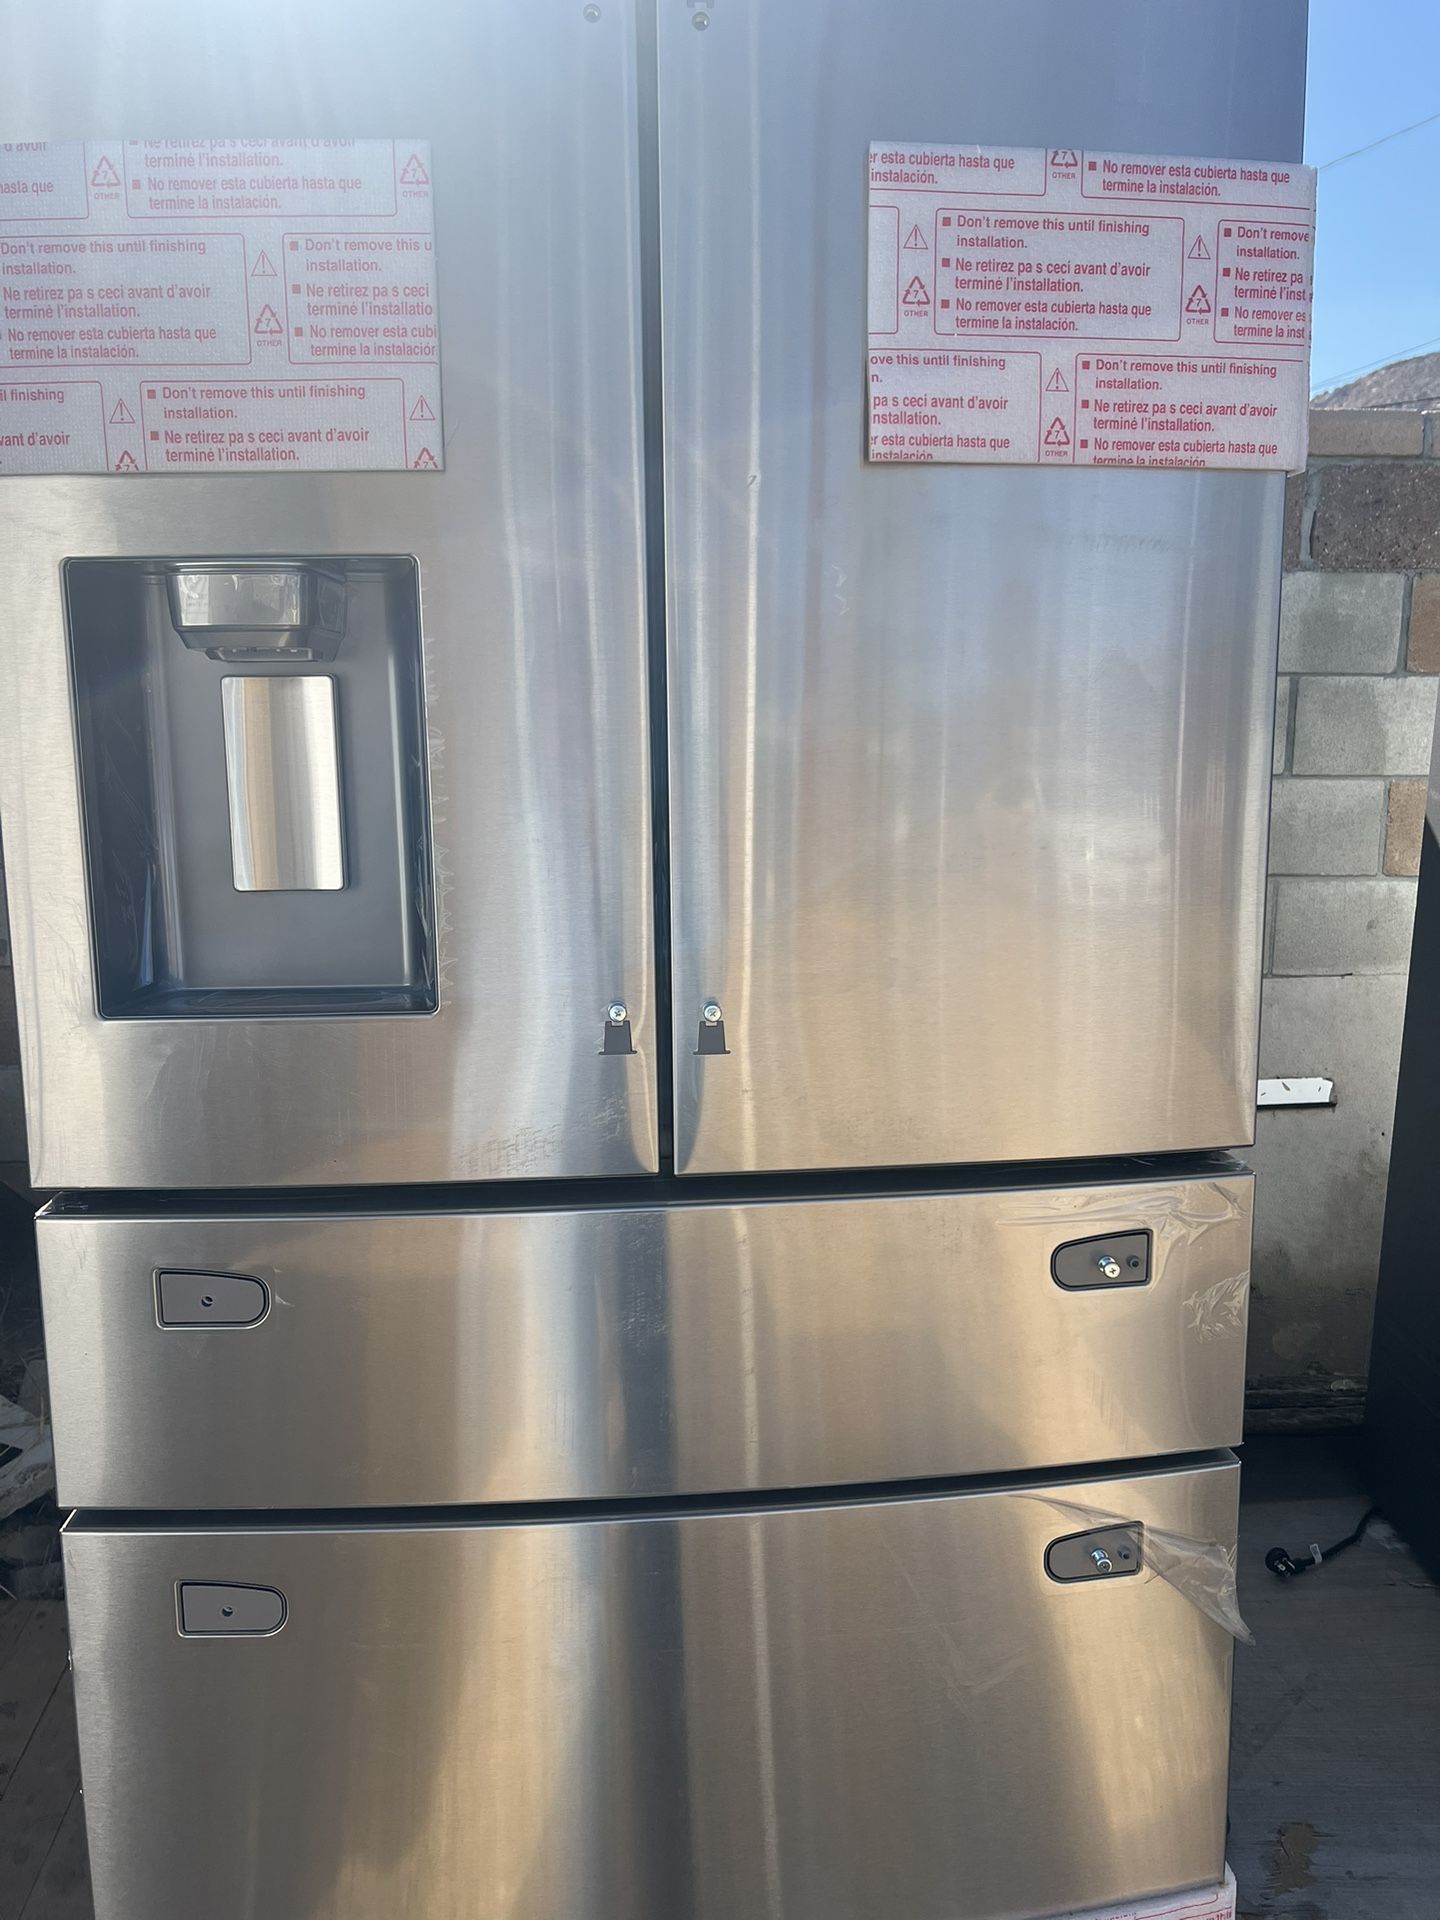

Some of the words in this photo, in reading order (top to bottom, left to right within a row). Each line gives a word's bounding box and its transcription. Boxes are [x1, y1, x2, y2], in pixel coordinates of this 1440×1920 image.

[881, 151, 905, 164] esta
[909, 152, 956, 167] cubierta
[958, 154, 990, 168] hasta
[993, 156, 1015, 172] que
[871, 168, 938, 184] instalación.
[1052, 171, 1076, 179] OTHER
[1103, 160, 1118, 174] No
[1121, 161, 1166, 176] remover
[1169, 162, 1191, 177] esta
[1194, 164, 1237, 180] cubierta
[1240, 166, 1268, 181] hasta
[1271, 170, 1290, 185] que
[31, 182, 54, 196] que
[147, 178, 165, 190] No
[168, 179, 217, 190] remover
[221, 178, 246, 190] esta
[249, 176, 299, 190] cubierta
[302, 176, 336, 190] hasta
[338, 178, 363, 192] que
[1103, 178, 1144, 193] termine
[1147, 180, 1156, 193] la
[1160, 181, 1221, 197] instalación.
[402, 190, 429, 198] OTHER
[149, 196, 195, 210] termine
[957, 215, 990, 229] Don't
[994, 217, 1039, 230] remove
[1043, 217, 1064, 231] this
[1068, 218, 1094, 232] until
[1099, 220, 1150, 236] finishing
[1237, 226, 1267, 240] Don't
[1, 241, 35, 255] Don't
[38, 242, 86, 254] remove
[89, 240, 113, 253] this
[117, 239, 145, 252] until
[150, 239, 206, 255] finishing
[304, 238, 340, 251] Don't
[344, 240, 392, 251] remove
[396, 238, 420, 250] this
[957, 234, 1027, 249] installation.
[1236, 245, 1300, 260] installation.
[2, 262, 76, 275] installation.
[306, 259, 382, 272] installation.
[956, 257, 972, 272] Ne
[976, 258, 1014, 273] retirez
[1018, 261, 1032, 276] pa
[1046, 260, 1070, 274] ceci
[1074, 262, 1106, 276] avant
[1110, 262, 1151, 277] d'avoir
[1235, 267, 1250, 281] Ne
[1253, 268, 1286, 282] retirez
[1290, 271, 1303, 285] pa
[306, 283, 324, 297] Ne
[328, 283, 368, 297] retirez
[372, 285, 388, 300] pa
[403, 282, 429, 296] ceci
[955, 276, 1002, 291] terminé
[1006, 277, 1084, 292] l'installation.
[3, 287, 20, 301] Ne
[23, 286, 64, 300] retirez
[67, 288, 83, 302] pa
[99, 284, 124, 299] ceci
[128, 286, 163, 299] avant
[167, 284, 210, 298] d'avoir
[1234, 285, 1277, 299] terminé
[4, 305, 53, 319] terminé
[57, 304, 140, 318] l'installation.
[307, 302, 358, 316] terminé
[956, 298, 972, 311] No
[975, 299, 1021, 312] remover
[1025, 299, 1048, 313] esta
[1051, 300, 1095, 314] cubierta
[1099, 301, 1128, 315] hasta
[1131, 304, 1152, 318] que
[1234, 306, 1249, 319] No
[1251, 308, 1293, 321] remover
[956, 315, 999, 329] termine
[1002, 315, 1012, 329] la
[1015, 316, 1078, 331] instalación.
[8, 328, 24, 342] No
[28, 329, 75, 341] remover
[79, 327, 103, 340] esta
[107, 325, 155, 340] cubierta
[159, 326, 191, 339] hasta
[195, 328, 217, 343] que
[309, 325, 327, 338] No
[330, 326, 378, 338] remover
[383, 325, 408, 338] esta
[1233, 324, 1273, 338] termine
[1276, 325, 1284, 338] la
[10, 346, 54, 360] termine
[71, 345, 139, 359] instalación.
[310, 343, 357, 357] termine
[360, 343, 370, 356] la
[896, 354, 919, 365] this
[923, 354, 950, 366] until
[953, 355, 1006, 370] finishing
[1096, 359, 1127, 371] Don't
[1130, 361, 1173, 373] remove
[1177, 361, 1198, 373] this
[1201, 362, 1226, 374] until
[1229, 363, 1277, 378] finishing
[1095, 377, 1162, 390] installation.
[11, 388, 65, 403] finishing
[162, 387, 196, 399] Don't
[200, 387, 247, 399] remove
[251, 386, 274, 398] this
[279, 385, 305, 398] until
[309, 385, 365, 400] finishing
[873, 395, 888, 409] pa
[902, 393, 927, 407] ceci
[931, 395, 964, 409] avant
[968, 396, 1009, 410] d'avoir
[1094, 400, 1110, 413] Ne
[1113, 400, 1149, 414] retirez
[1152, 403, 1166, 417] pa
[1179, 402, 1203, 415] ceci
[1206, 403, 1237, 416] avant
[1239, 403, 1277, 417] d'avoir
[163, 406, 238, 420] installation.
[1093, 417, 1138, 430] terminé
[1141, 417, 1215, 432] l'installation.
[28, 431, 70, 446] d'avoir
[165, 430, 182, 444] Ne
[185, 429, 224, 443] retirez
[229, 432, 244, 446] pa
[258, 428, 284, 443] ceci
[288, 429, 322, 442] avant
[325, 428, 369, 441] d'avoir
[881, 433, 905, 446] esta
[909, 433, 954, 447] cubierta
[957, 434, 986, 448] hasta
[989, 438, 1010, 452] que
[165, 448, 214, 462] terminé
[218, 447, 300, 461] l'installation.
[1094, 437, 1109, 450] No
[1112, 440, 1156, 452] remover
[1158, 439, 1181, 452] esta
[1183, 440, 1225, 453] cubierta
[1228, 441, 1256, 454] hasta
[1259, 444, 1278, 457] que
